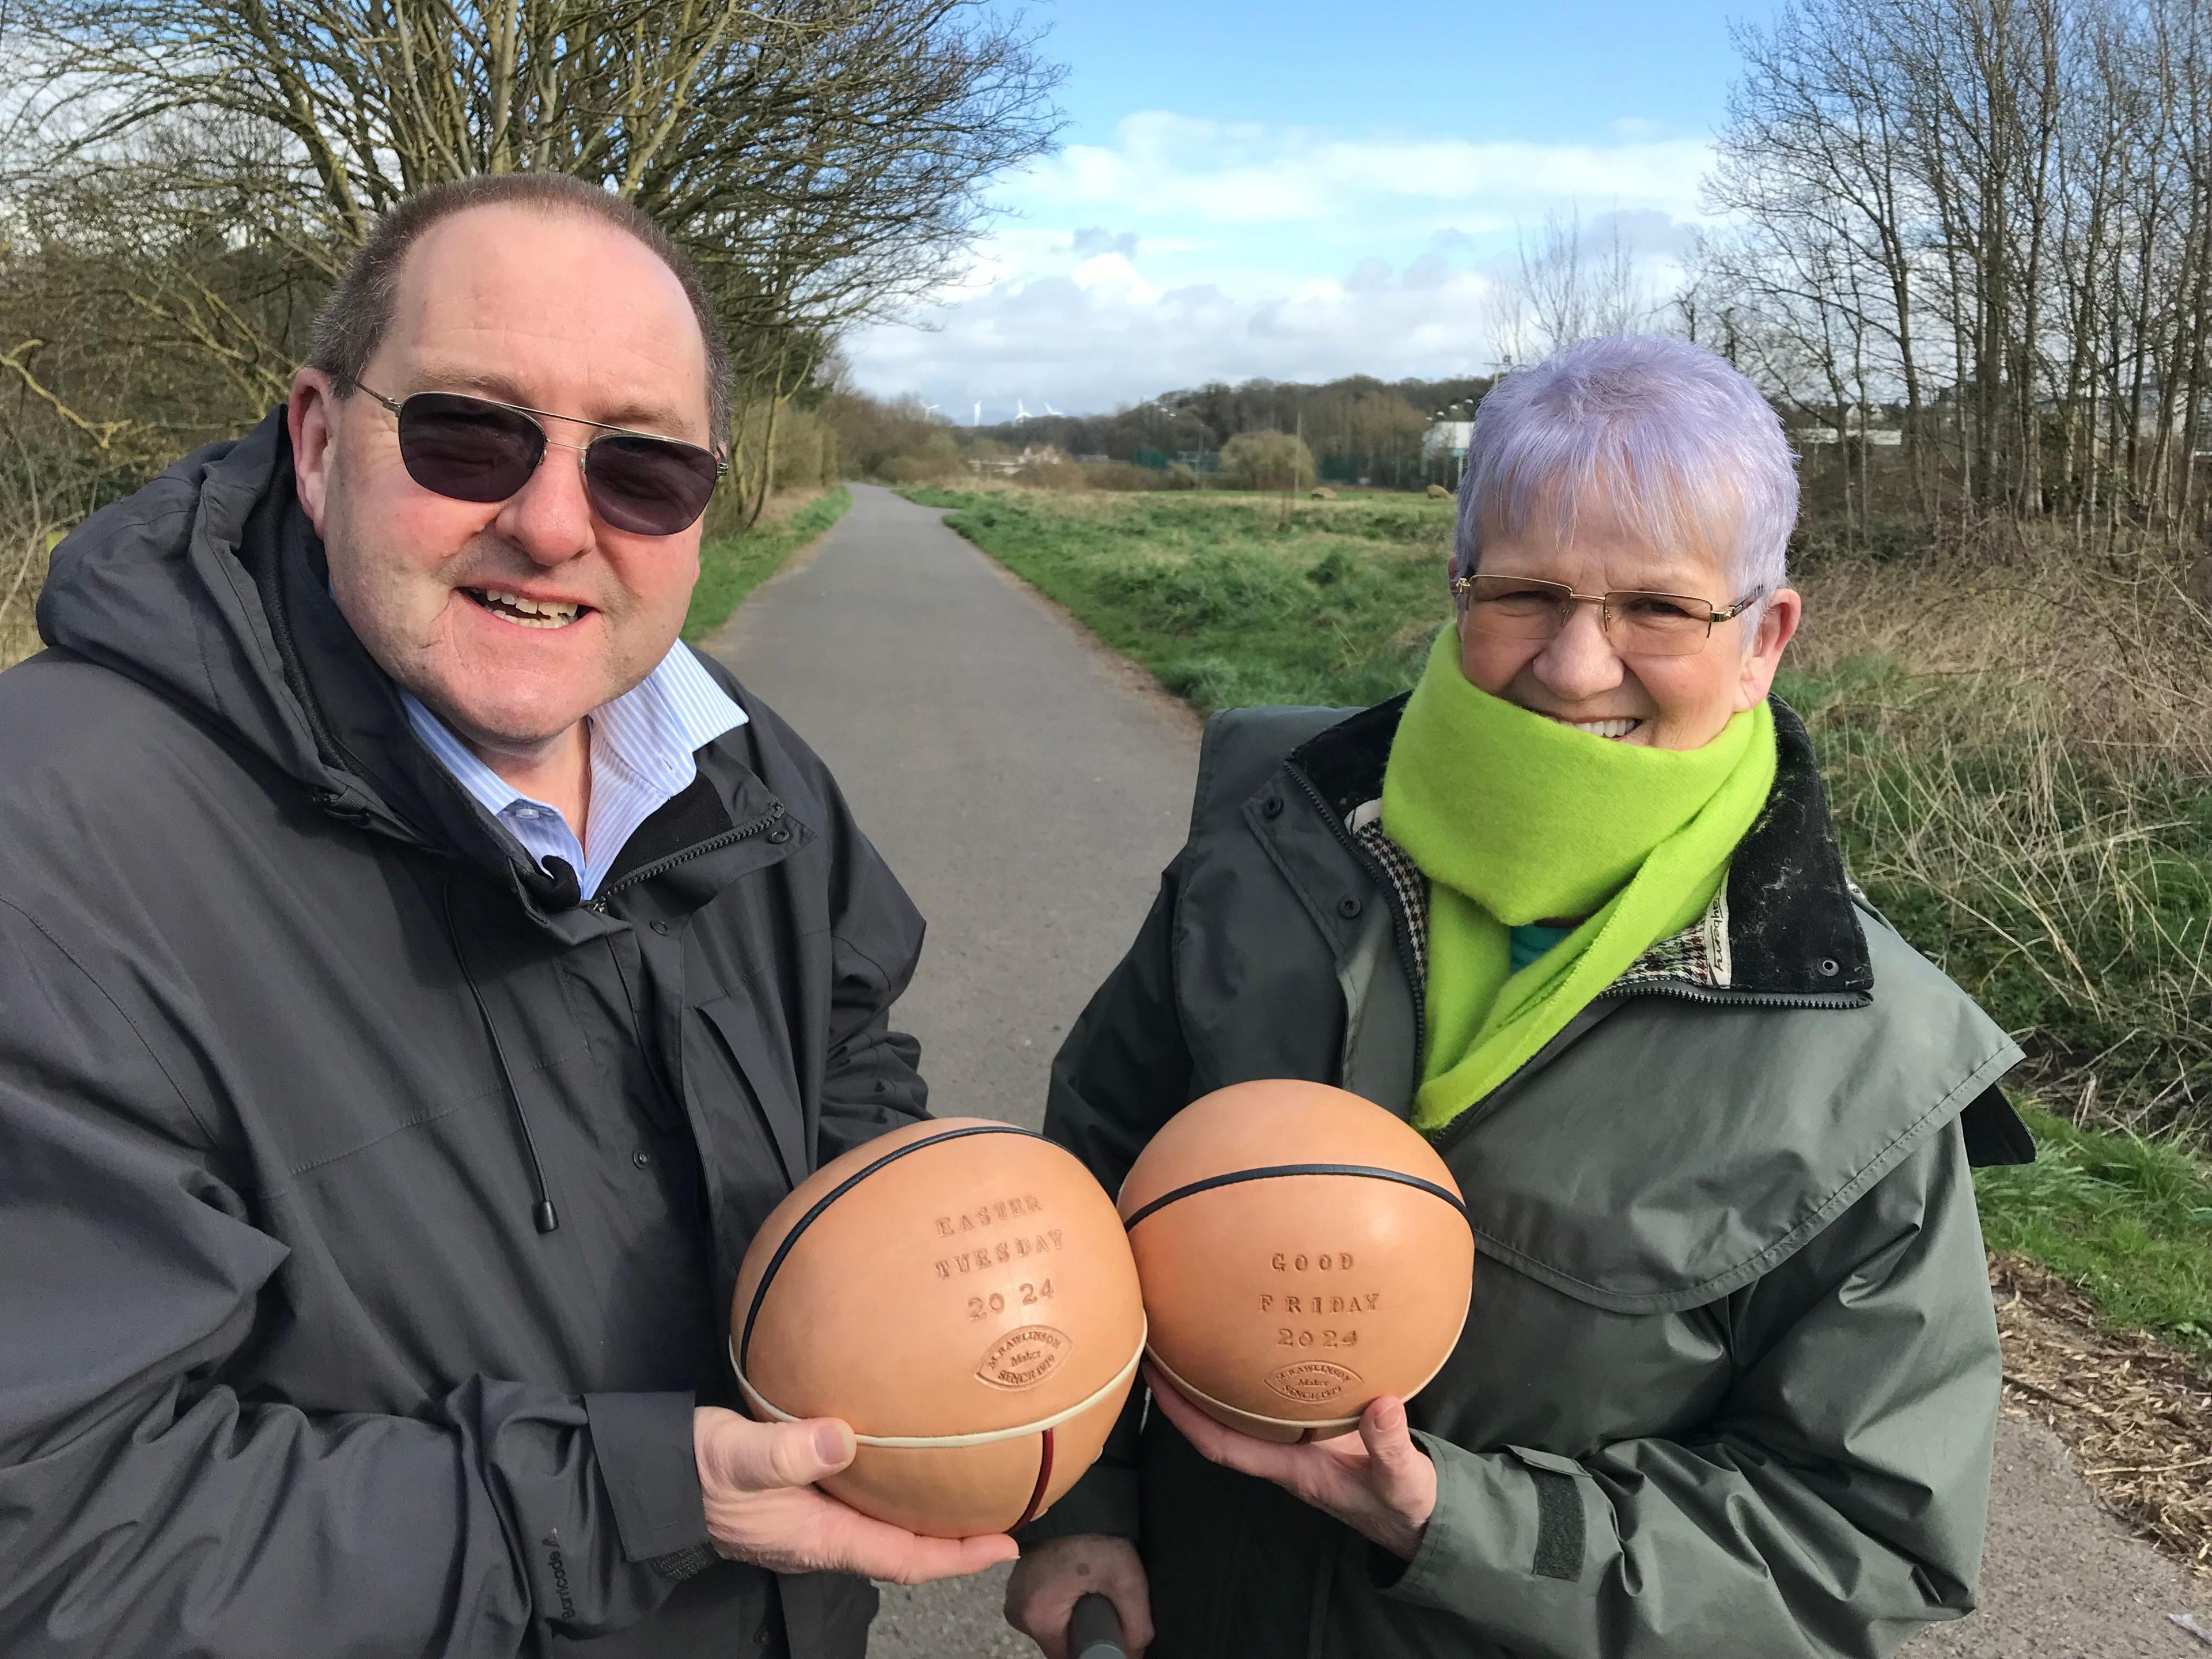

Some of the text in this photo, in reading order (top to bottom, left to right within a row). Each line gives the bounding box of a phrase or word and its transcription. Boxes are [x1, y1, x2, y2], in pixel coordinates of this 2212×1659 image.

[935, 1195, 1042, 1238] EASTER
[934, 1230, 1063, 1281] TUESDAY
[1271, 1253, 1354, 1271] GOOD
[1259, 1293, 1380, 1314] FRIDAY
[1277, 1328, 1358, 1349] 2024
